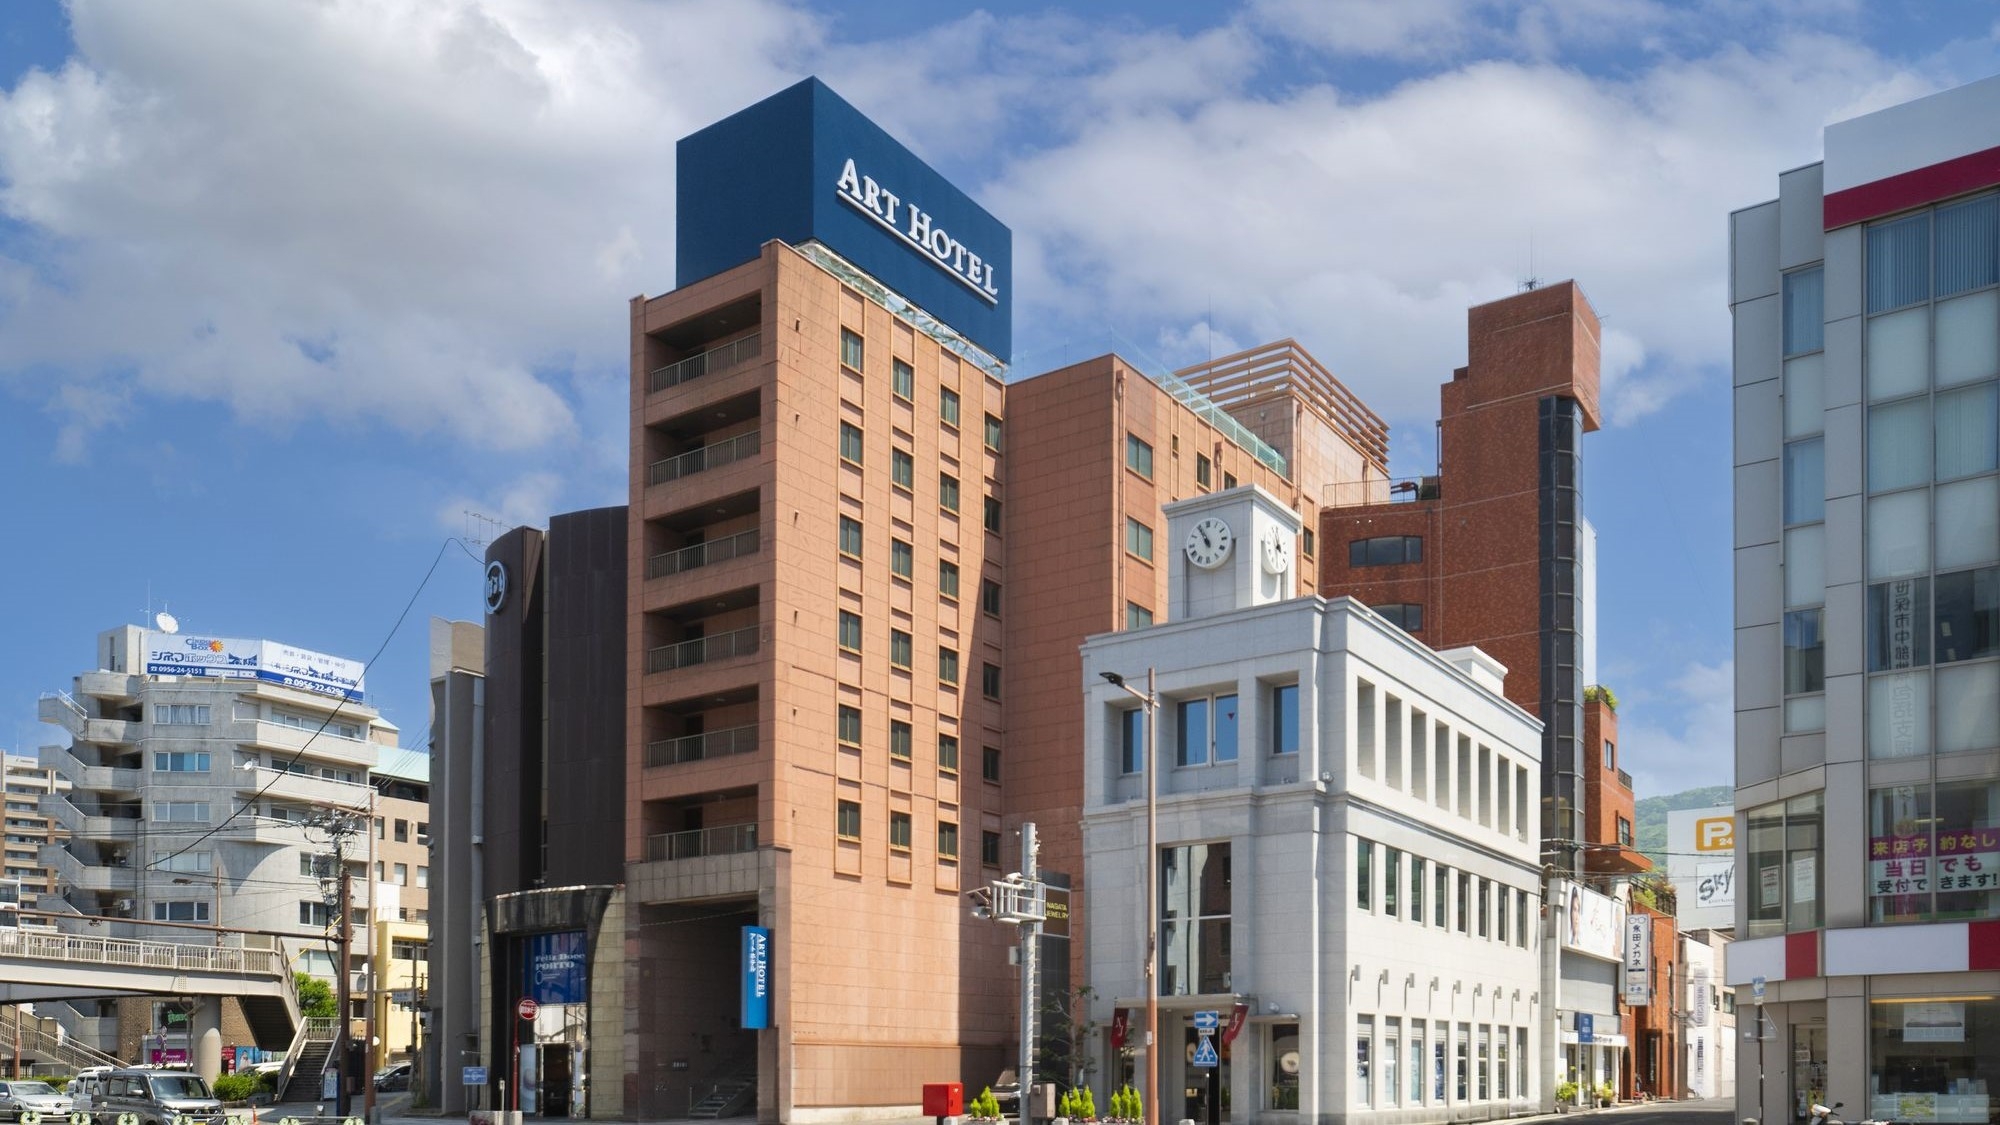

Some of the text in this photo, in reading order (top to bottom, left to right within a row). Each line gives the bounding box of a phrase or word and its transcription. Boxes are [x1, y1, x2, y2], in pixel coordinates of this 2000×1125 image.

[836, 158, 998, 296] ART HOTEL
[1703, 821, 1733, 847] P
[757, 933, 767, 997] ART HOTEL
